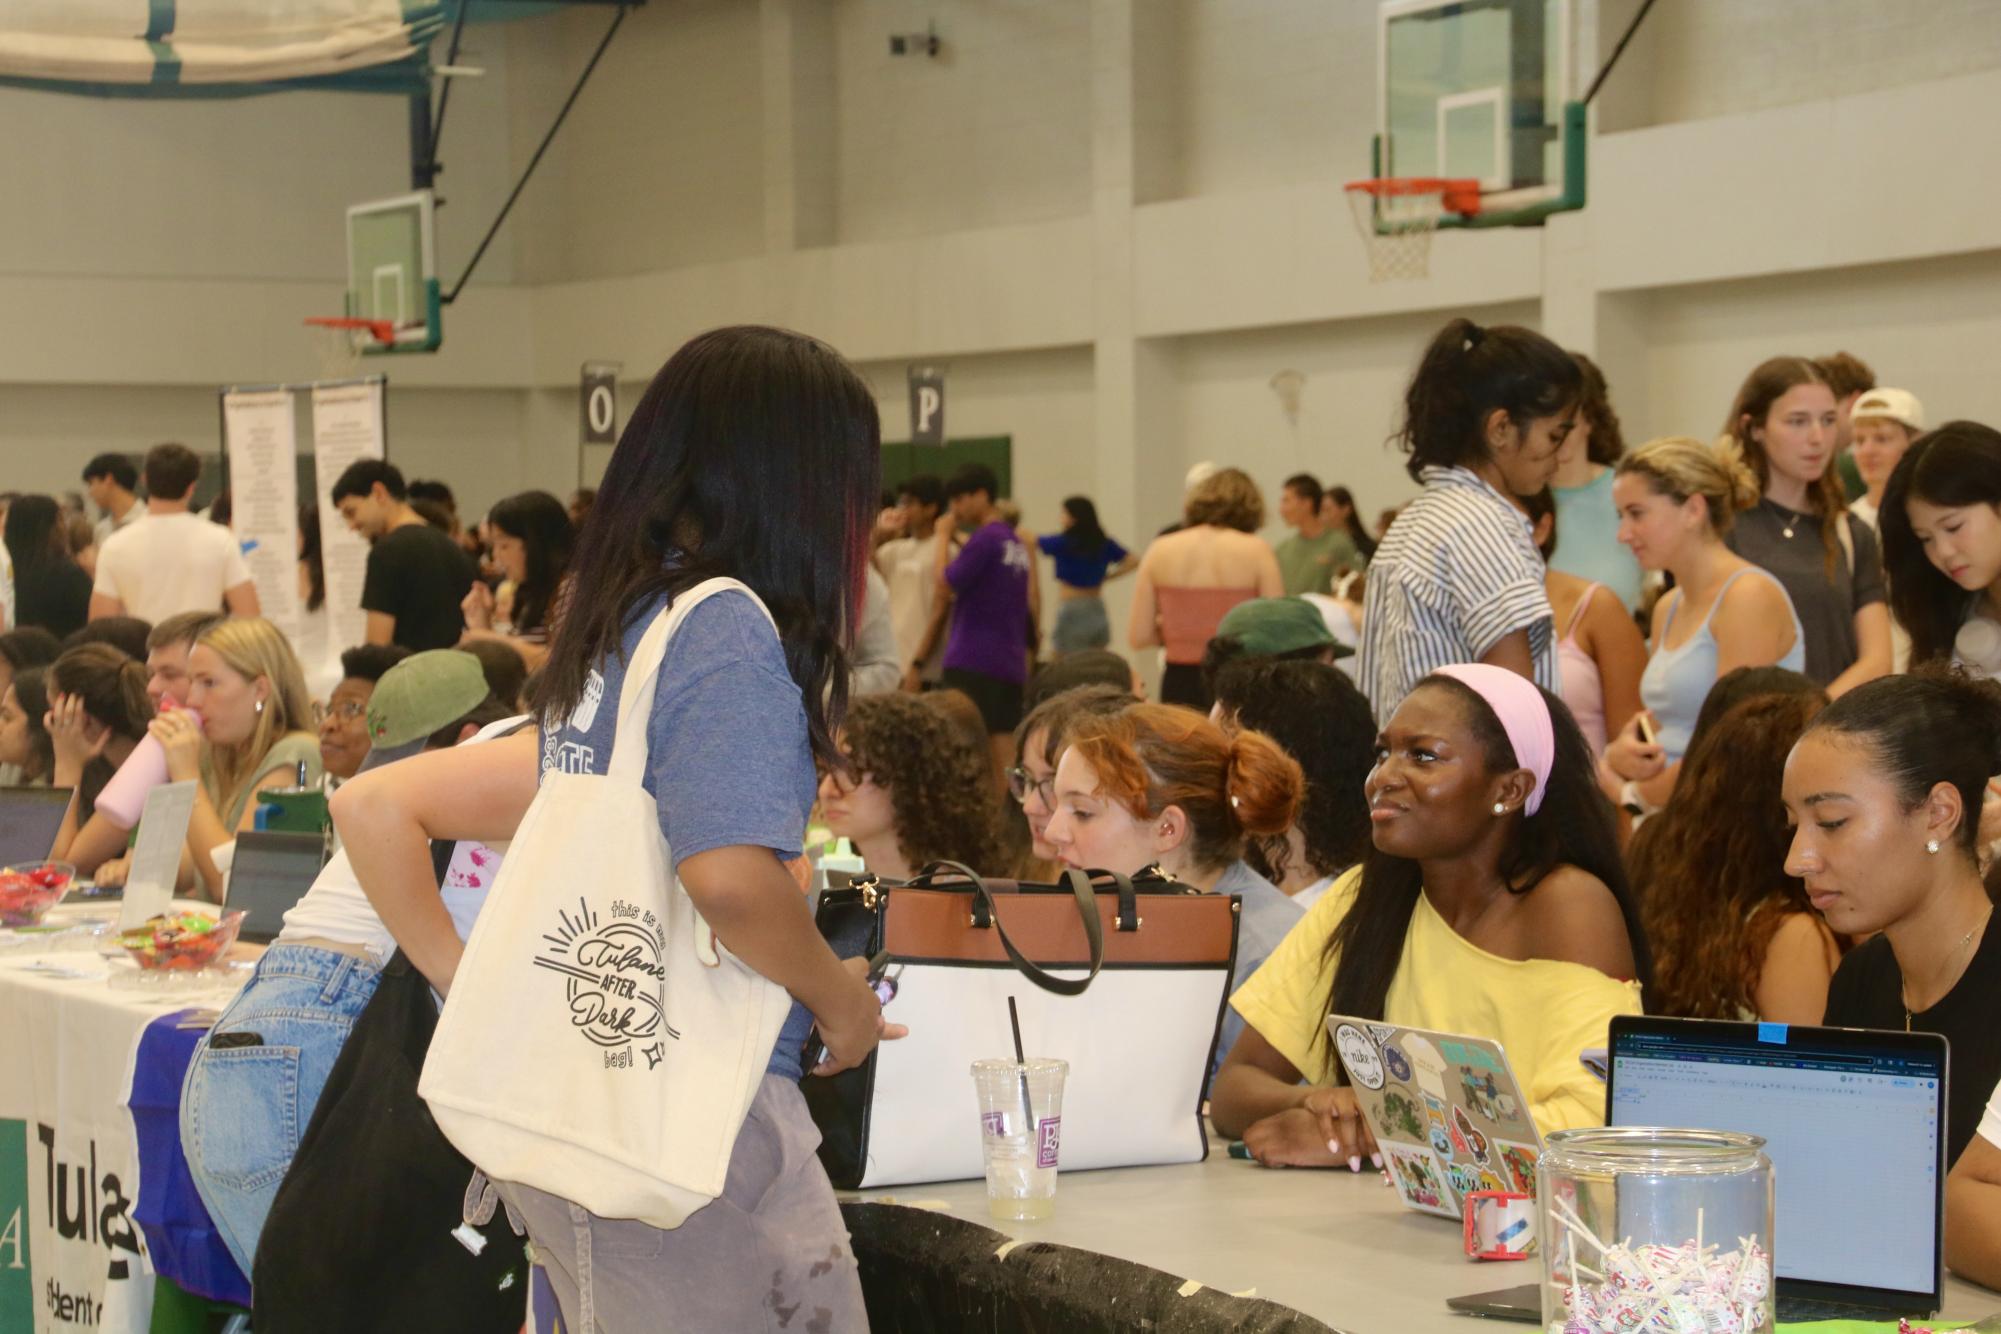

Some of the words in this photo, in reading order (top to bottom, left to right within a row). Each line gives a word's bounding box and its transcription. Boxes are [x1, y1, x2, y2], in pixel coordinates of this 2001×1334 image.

[917, 386, 940, 433] P
[611, 899, 641, 919] this
[642, 909, 656, 927] is
[577, 939, 666, 982] Tulane
[600, 973, 637, 1001] AFTER
[569, 991, 656, 1038] Dark
[603, 1046, 634, 1069] bag!
[37, 1122, 142, 1257] Tula
